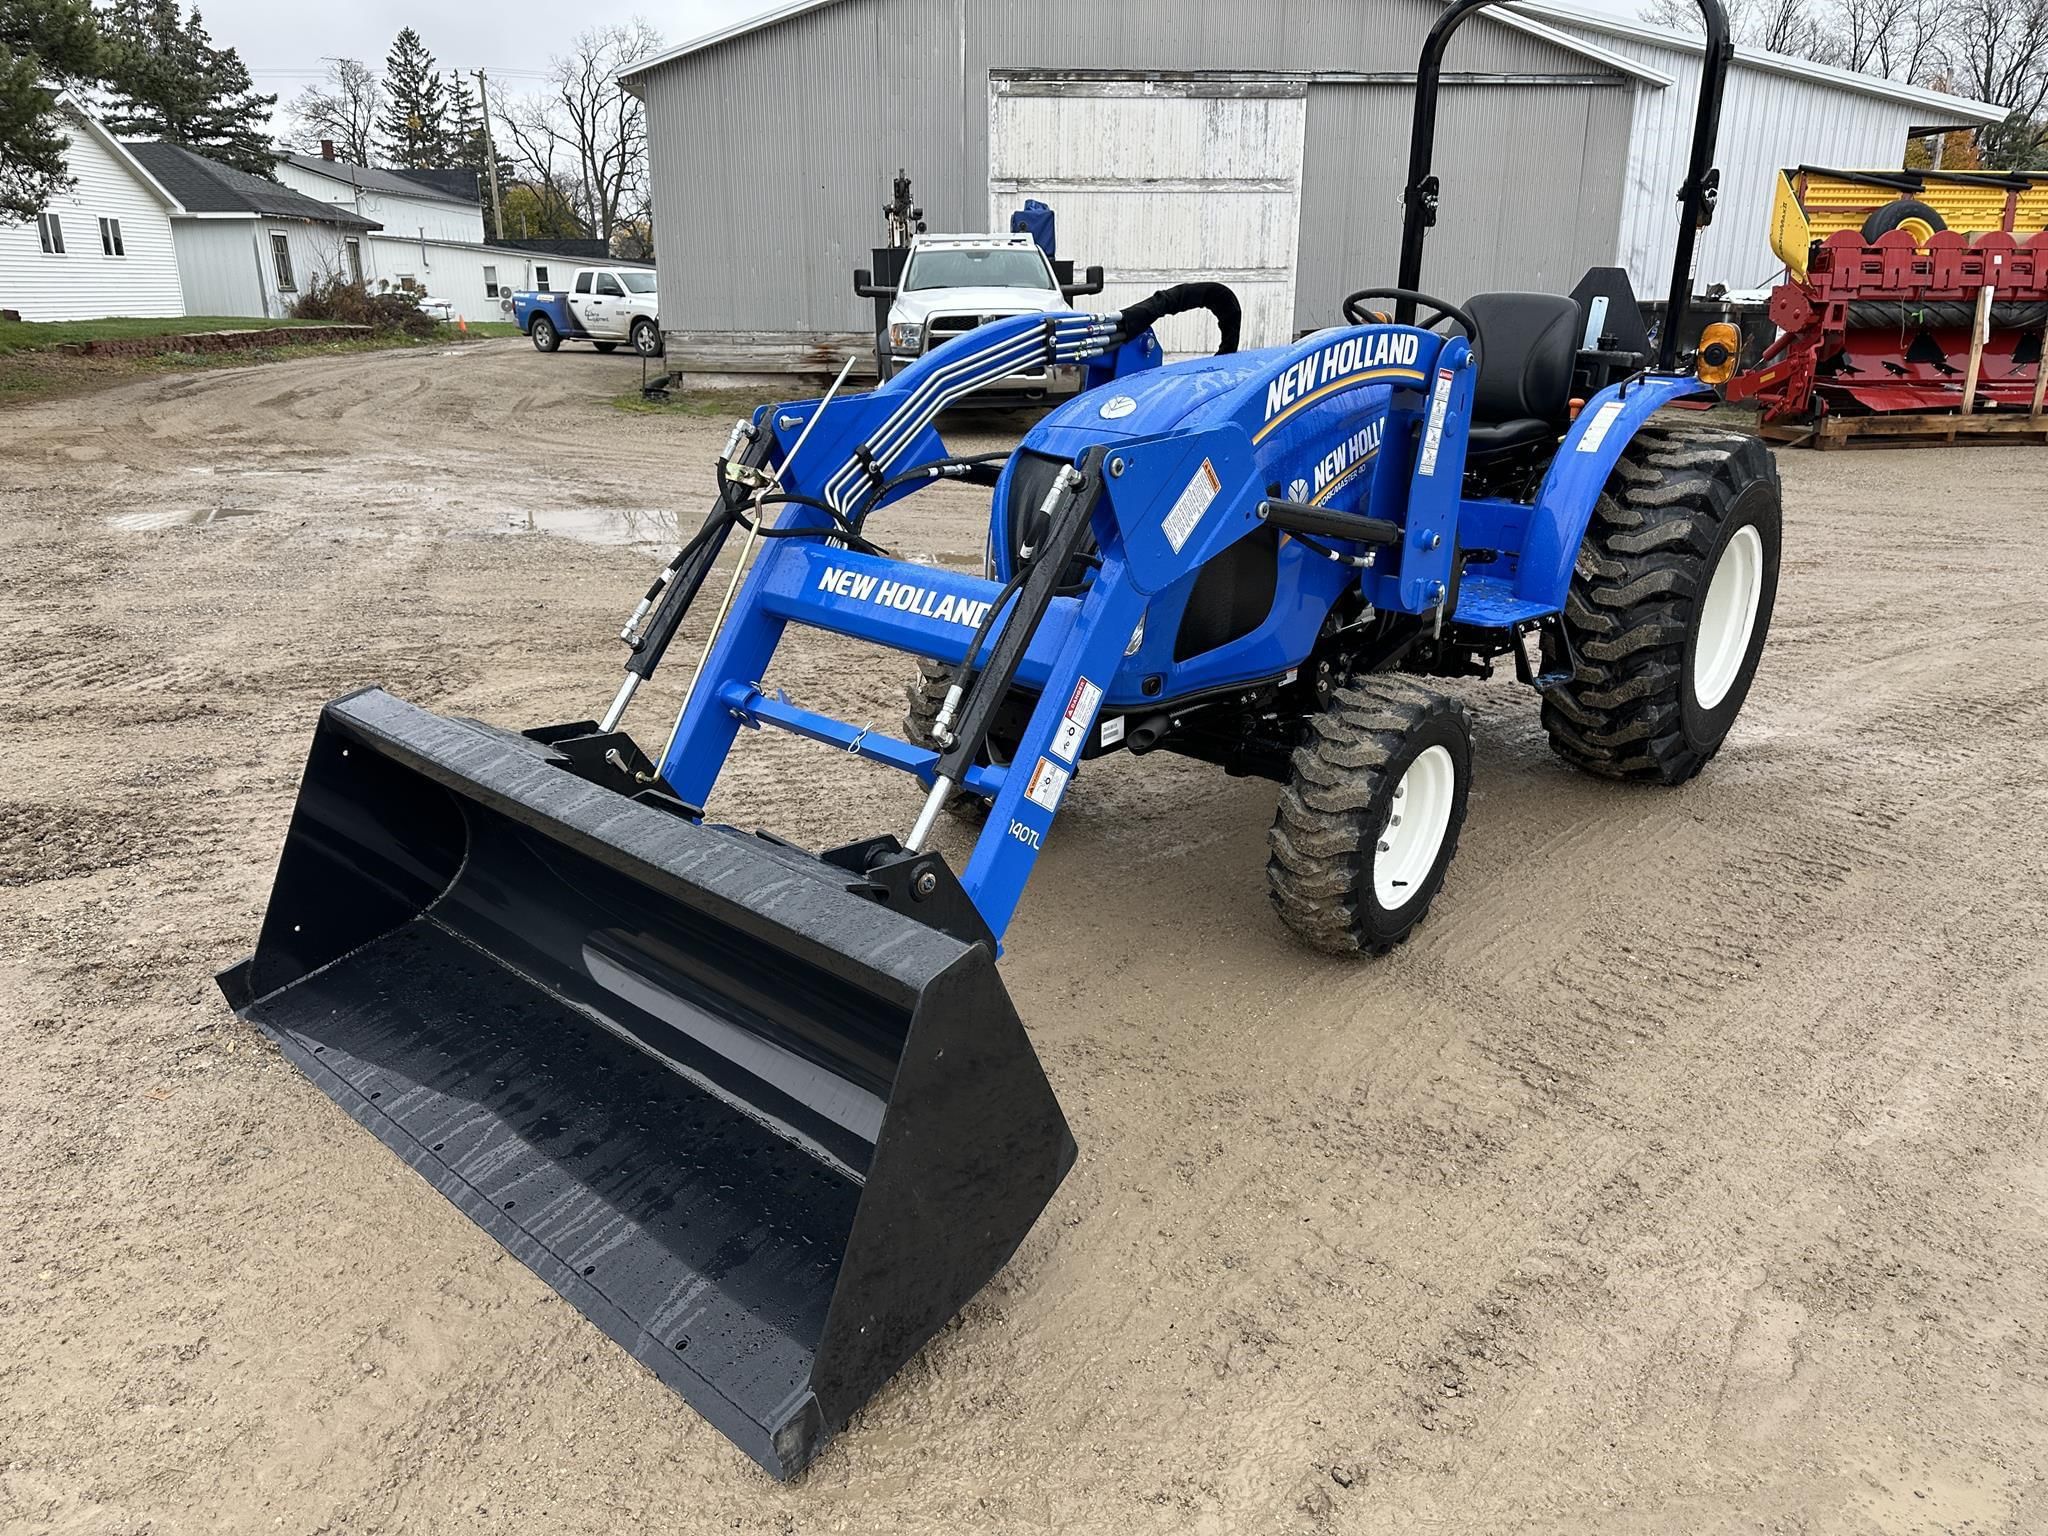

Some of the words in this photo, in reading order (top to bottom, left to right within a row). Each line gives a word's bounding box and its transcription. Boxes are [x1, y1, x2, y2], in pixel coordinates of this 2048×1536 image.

[1264, 350, 1321, 422] NEW
[1321, 333, 1419, 384] HOLLAND
[1314, 442, 1346, 494] NEW
[817, 566, 879, 601] NEW
[874, 579, 993, 629] HOLLAND
[1071, 680, 1088, 710] DANGER
[1008, 818, 1040, 851] 140TL
